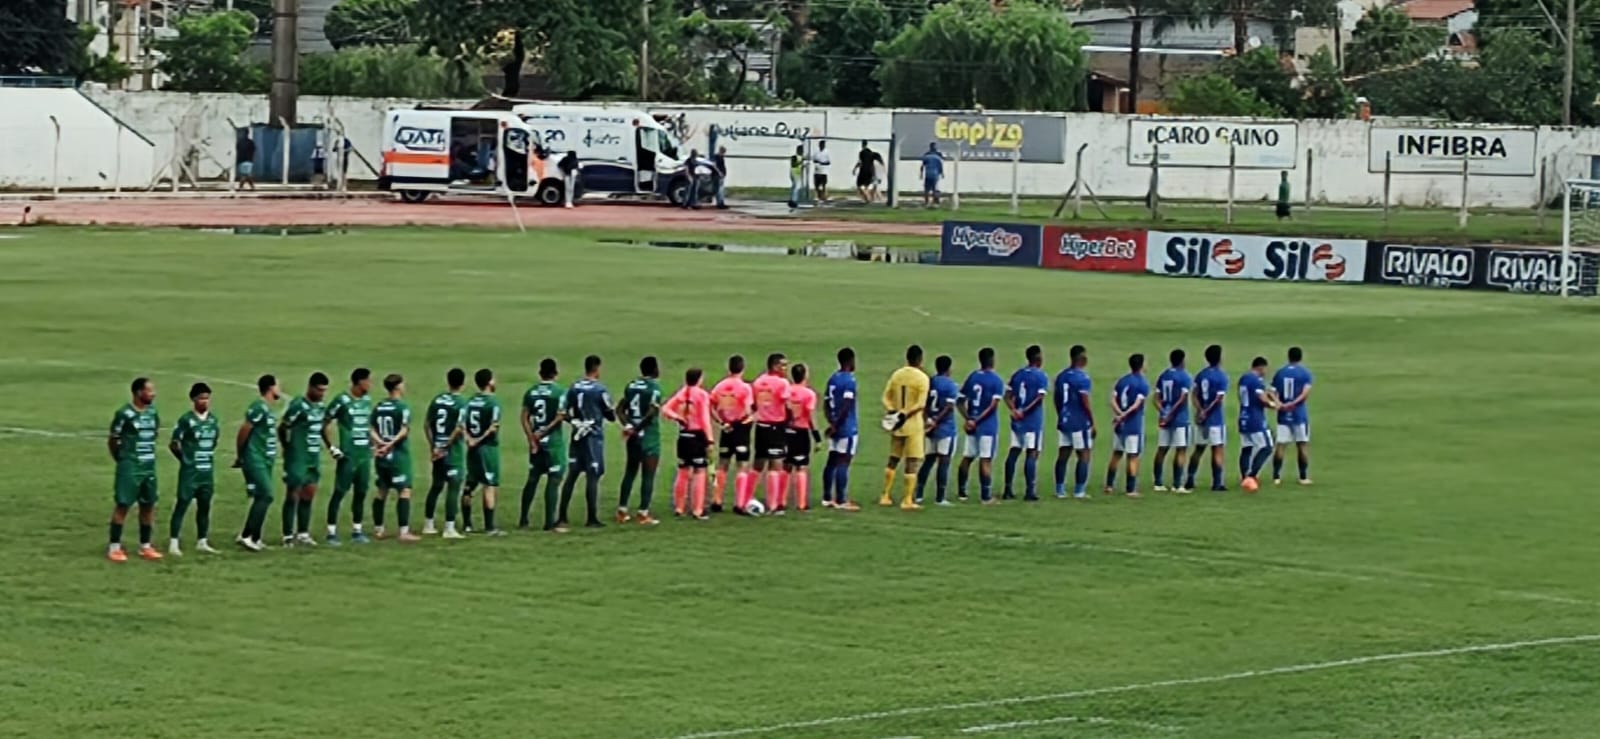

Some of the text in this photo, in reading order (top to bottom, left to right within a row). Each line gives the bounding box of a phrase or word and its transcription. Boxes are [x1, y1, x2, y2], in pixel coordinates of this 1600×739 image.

[934, 116, 1023, 149] Empiza
[1215, 127, 1279, 146] GAINO
[1398, 134, 1507, 158] INFIBRA
[1059, 233, 1137, 259] HiperBet
[1164, 236, 1211, 275] Sil
[1263, 240, 1311, 279] Sil
[1387, 250, 1468, 277] RIVALO
[1493, 256, 1577, 282] RIVALO
[630, 393, 640, 416] 4
[901, 385, 906, 408] 1
[930, 389, 939, 412] 2
[973, 384, 982, 407] 3
[436, 408, 447, 433] 2
[534, 399, 546, 422] 3
[376, 416, 394, 439] 10
[470, 411, 480, 434] 5
